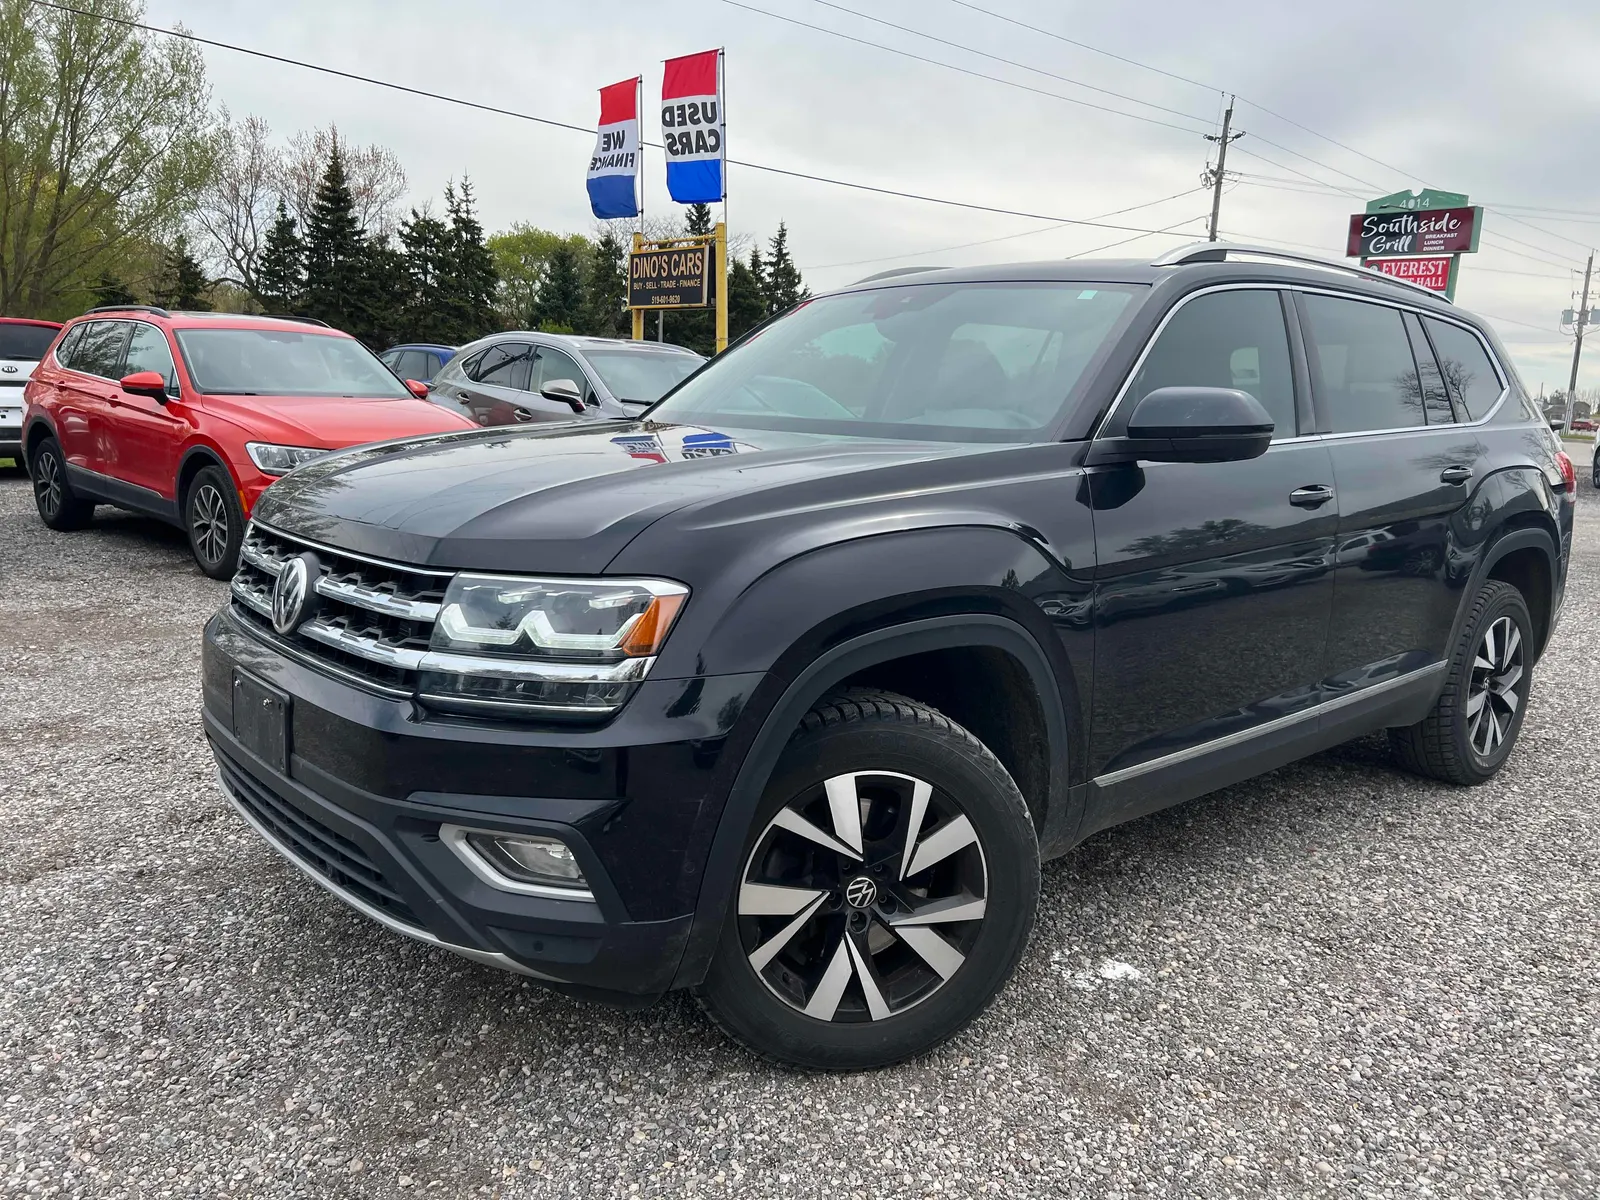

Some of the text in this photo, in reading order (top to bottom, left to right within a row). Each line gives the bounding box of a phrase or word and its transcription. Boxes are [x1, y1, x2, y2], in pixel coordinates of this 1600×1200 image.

[1361, 213, 1461, 238] Southside
[1369, 235, 1412, 254] Grill
[633, 252, 702, 279] DINO'S CARS
[1382, 260, 1447, 276] EVEREST
[633, 279, 700, 290] BUY SELL TRADE FINANCE
[1416, 276, 1444, 287] HALL
